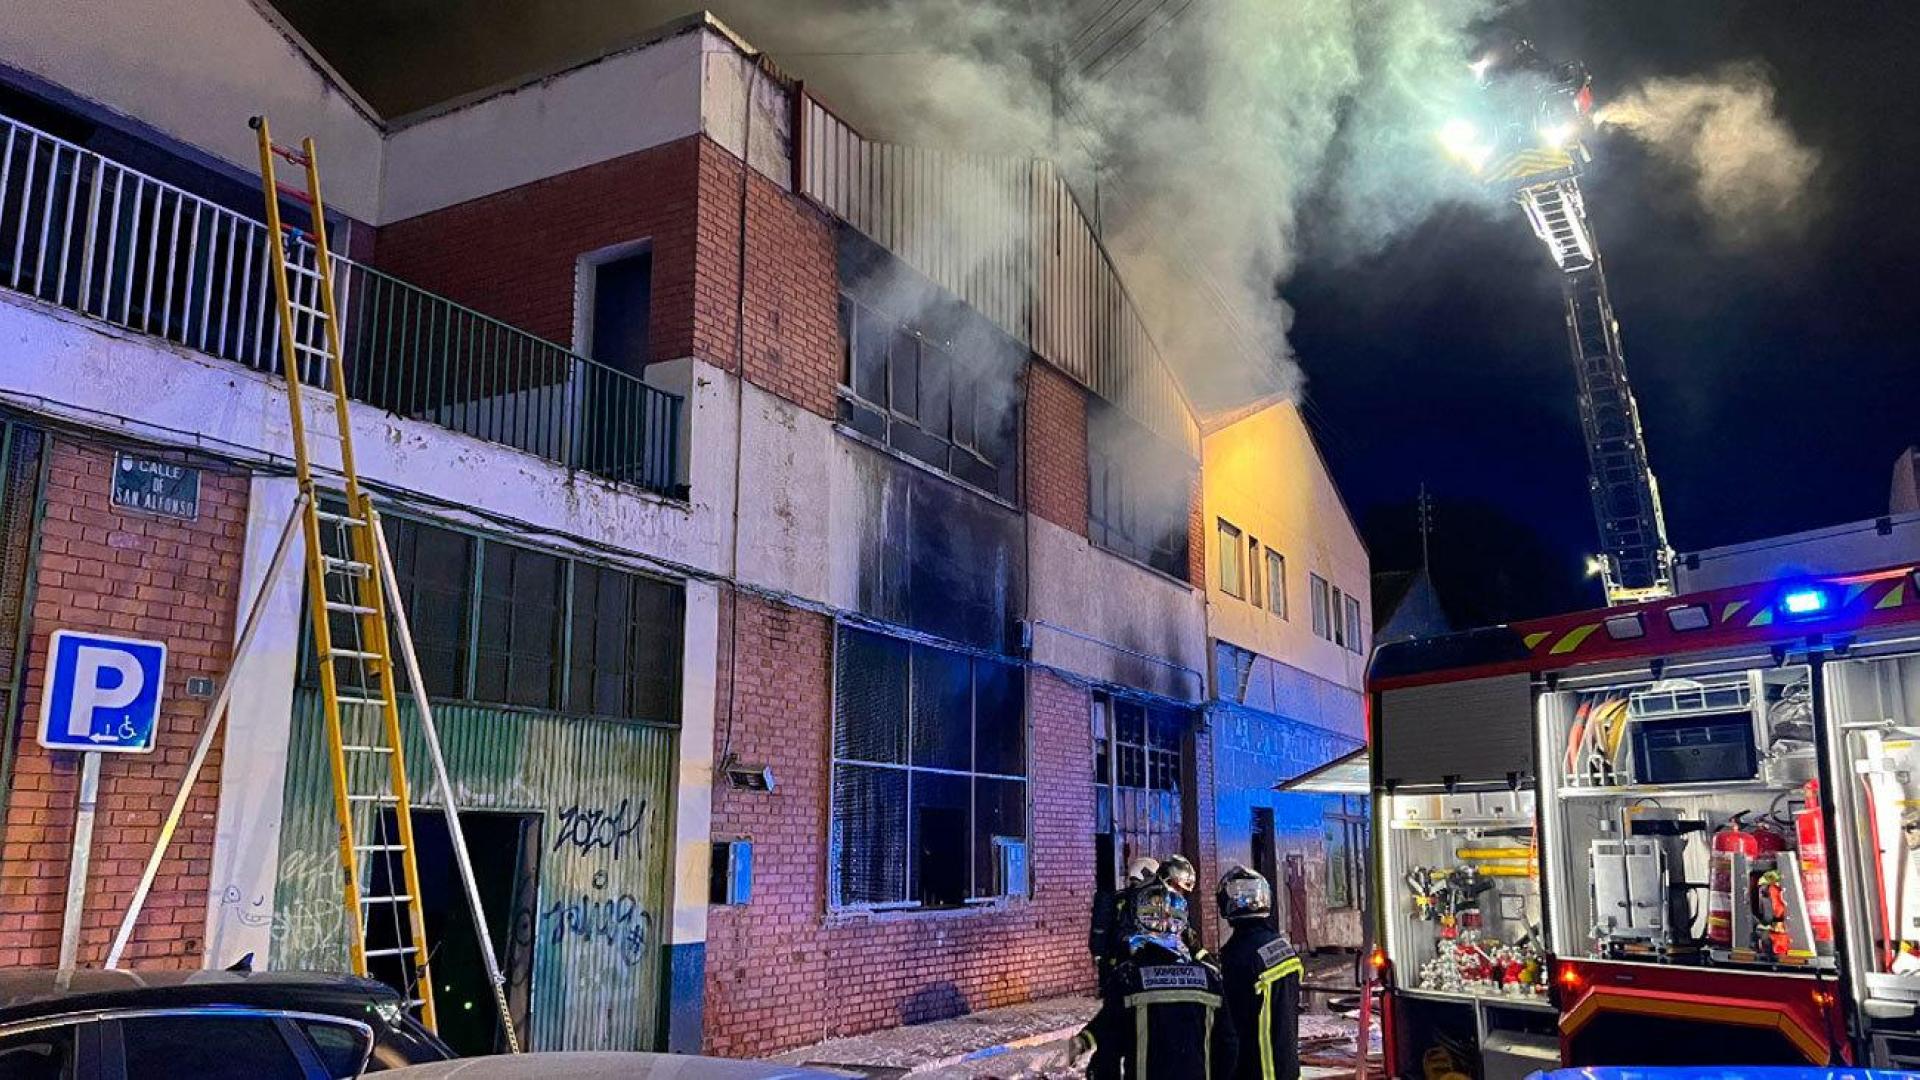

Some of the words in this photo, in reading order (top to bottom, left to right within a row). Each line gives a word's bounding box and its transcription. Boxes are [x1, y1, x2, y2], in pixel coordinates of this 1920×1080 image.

[139, 460, 181, 479] CALLE
[152, 477, 164, 492] DE
[115, 487, 140, 506] SAN
[143, 493, 194, 517] ALFONSO
[68, 645, 145, 737] P
